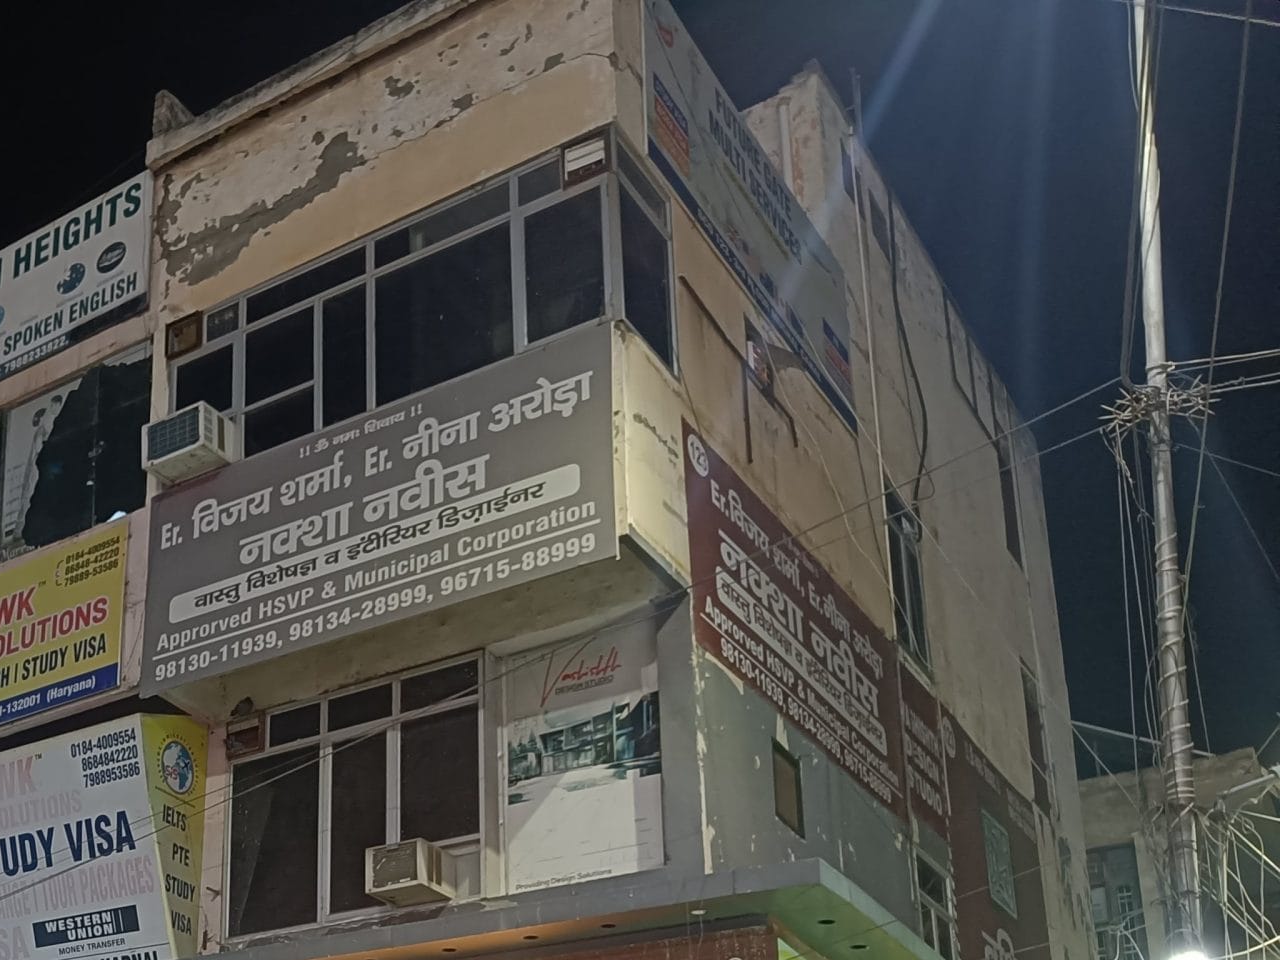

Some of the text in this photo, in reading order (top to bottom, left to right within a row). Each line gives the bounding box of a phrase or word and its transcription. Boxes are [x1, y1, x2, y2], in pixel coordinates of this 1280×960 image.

[12, 182, 142, 280] HEIGHTS
[3, 308, 64, 357] SPOKEN
[69, 271, 139, 322] ENGLISH
[160, 370, 595, 551] Er. विजय शर्मा, Er. नीना अरोड़ा
[239, 453, 492, 569] नक्शा नवीस
[193, 518, 433, 611] वास्तु विशेषज्ञ व इंटीरियर
[259, 499, 597, 622] HSVP & Municipal Corporation
[154, 532, 597, 683] 98130-11939, 98134-28999, 96715-88999
[718, 528, 805, 643] नक्शा
[809, 620, 880, 718] नवीस
[21, 645, 70, 682] STUDY
[73, 633, 108, 664] VISA
[765, 645, 796, 686] HSVP
[45, 676, 97, 706] (Haryana)
[70, 727, 137, 759] 0184-4009554
[81, 747, 140, 771] 8684842220
[83, 763, 141, 789] 7988953586
[63, 810, 138, 864] VISA
[161, 803, 188, 832] IELTS
[172, 842, 191, 867] PTE
[45, 910, 112, 933] WESTERN
[66, 923, 114, 942] UNION
[170, 909, 192, 937] VISA
[58, 936, 126, 956] MONEY TRANSFER
